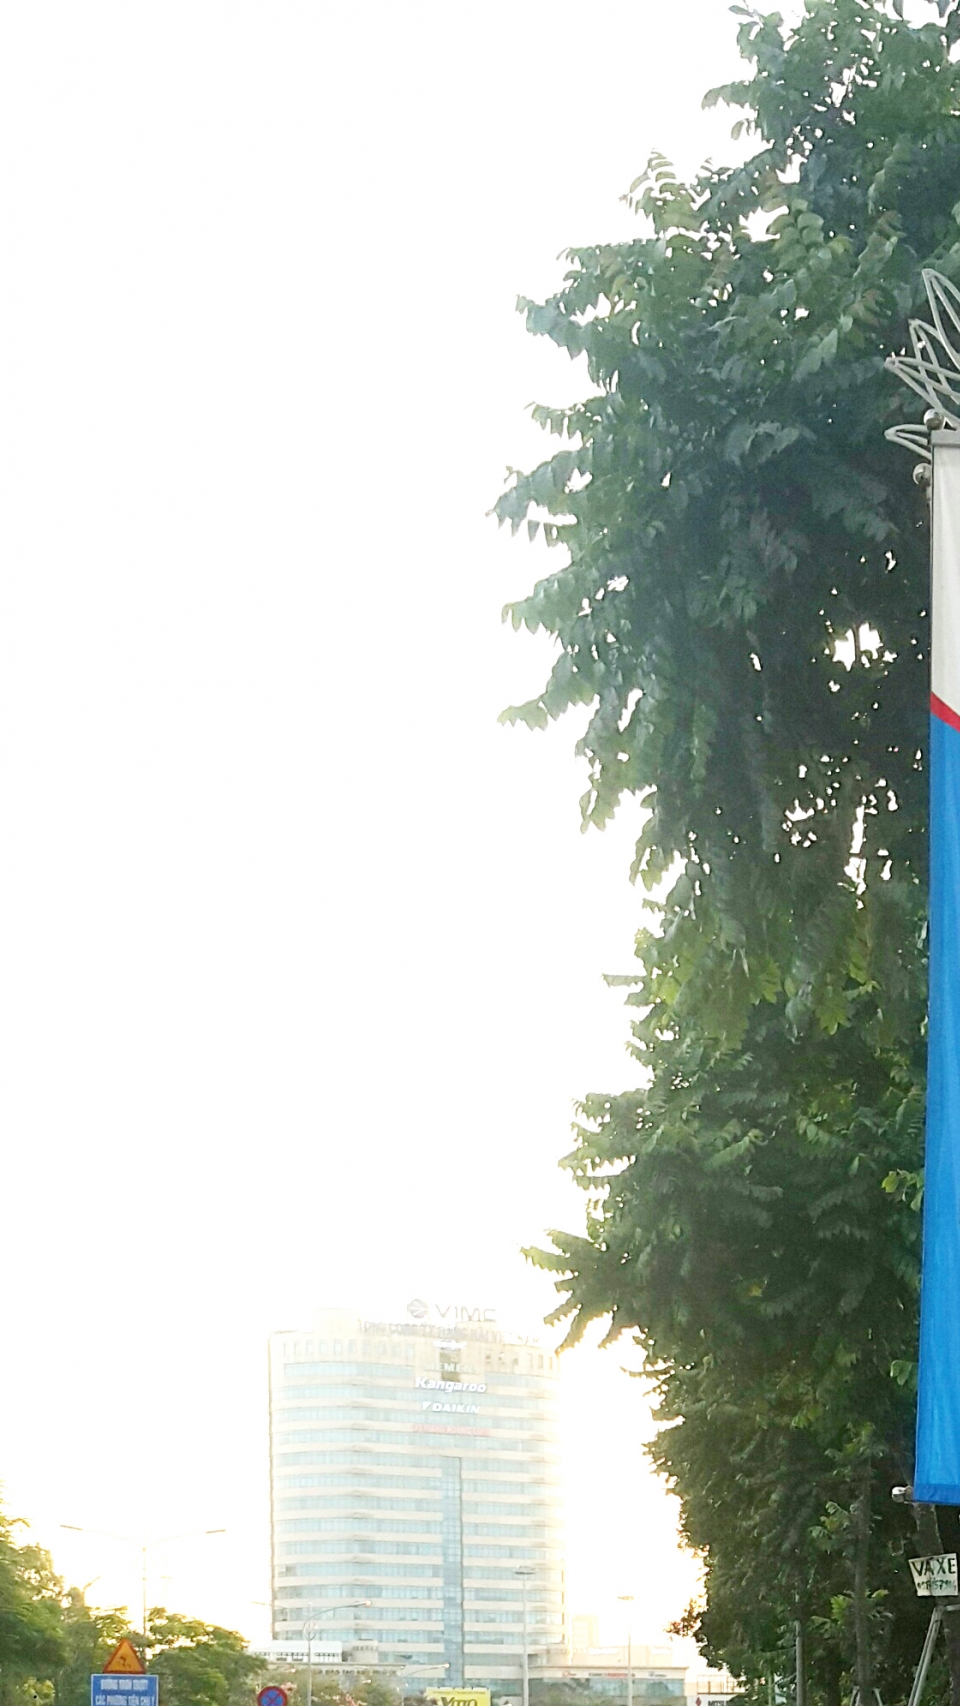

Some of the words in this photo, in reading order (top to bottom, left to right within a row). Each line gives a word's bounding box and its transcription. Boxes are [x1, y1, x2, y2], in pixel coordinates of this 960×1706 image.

[435, 1303, 496, 1322] VIMC
[415, 1377, 487, 1393] Kangaroo
[432, 1402, 480, 1414] DAIKIN
